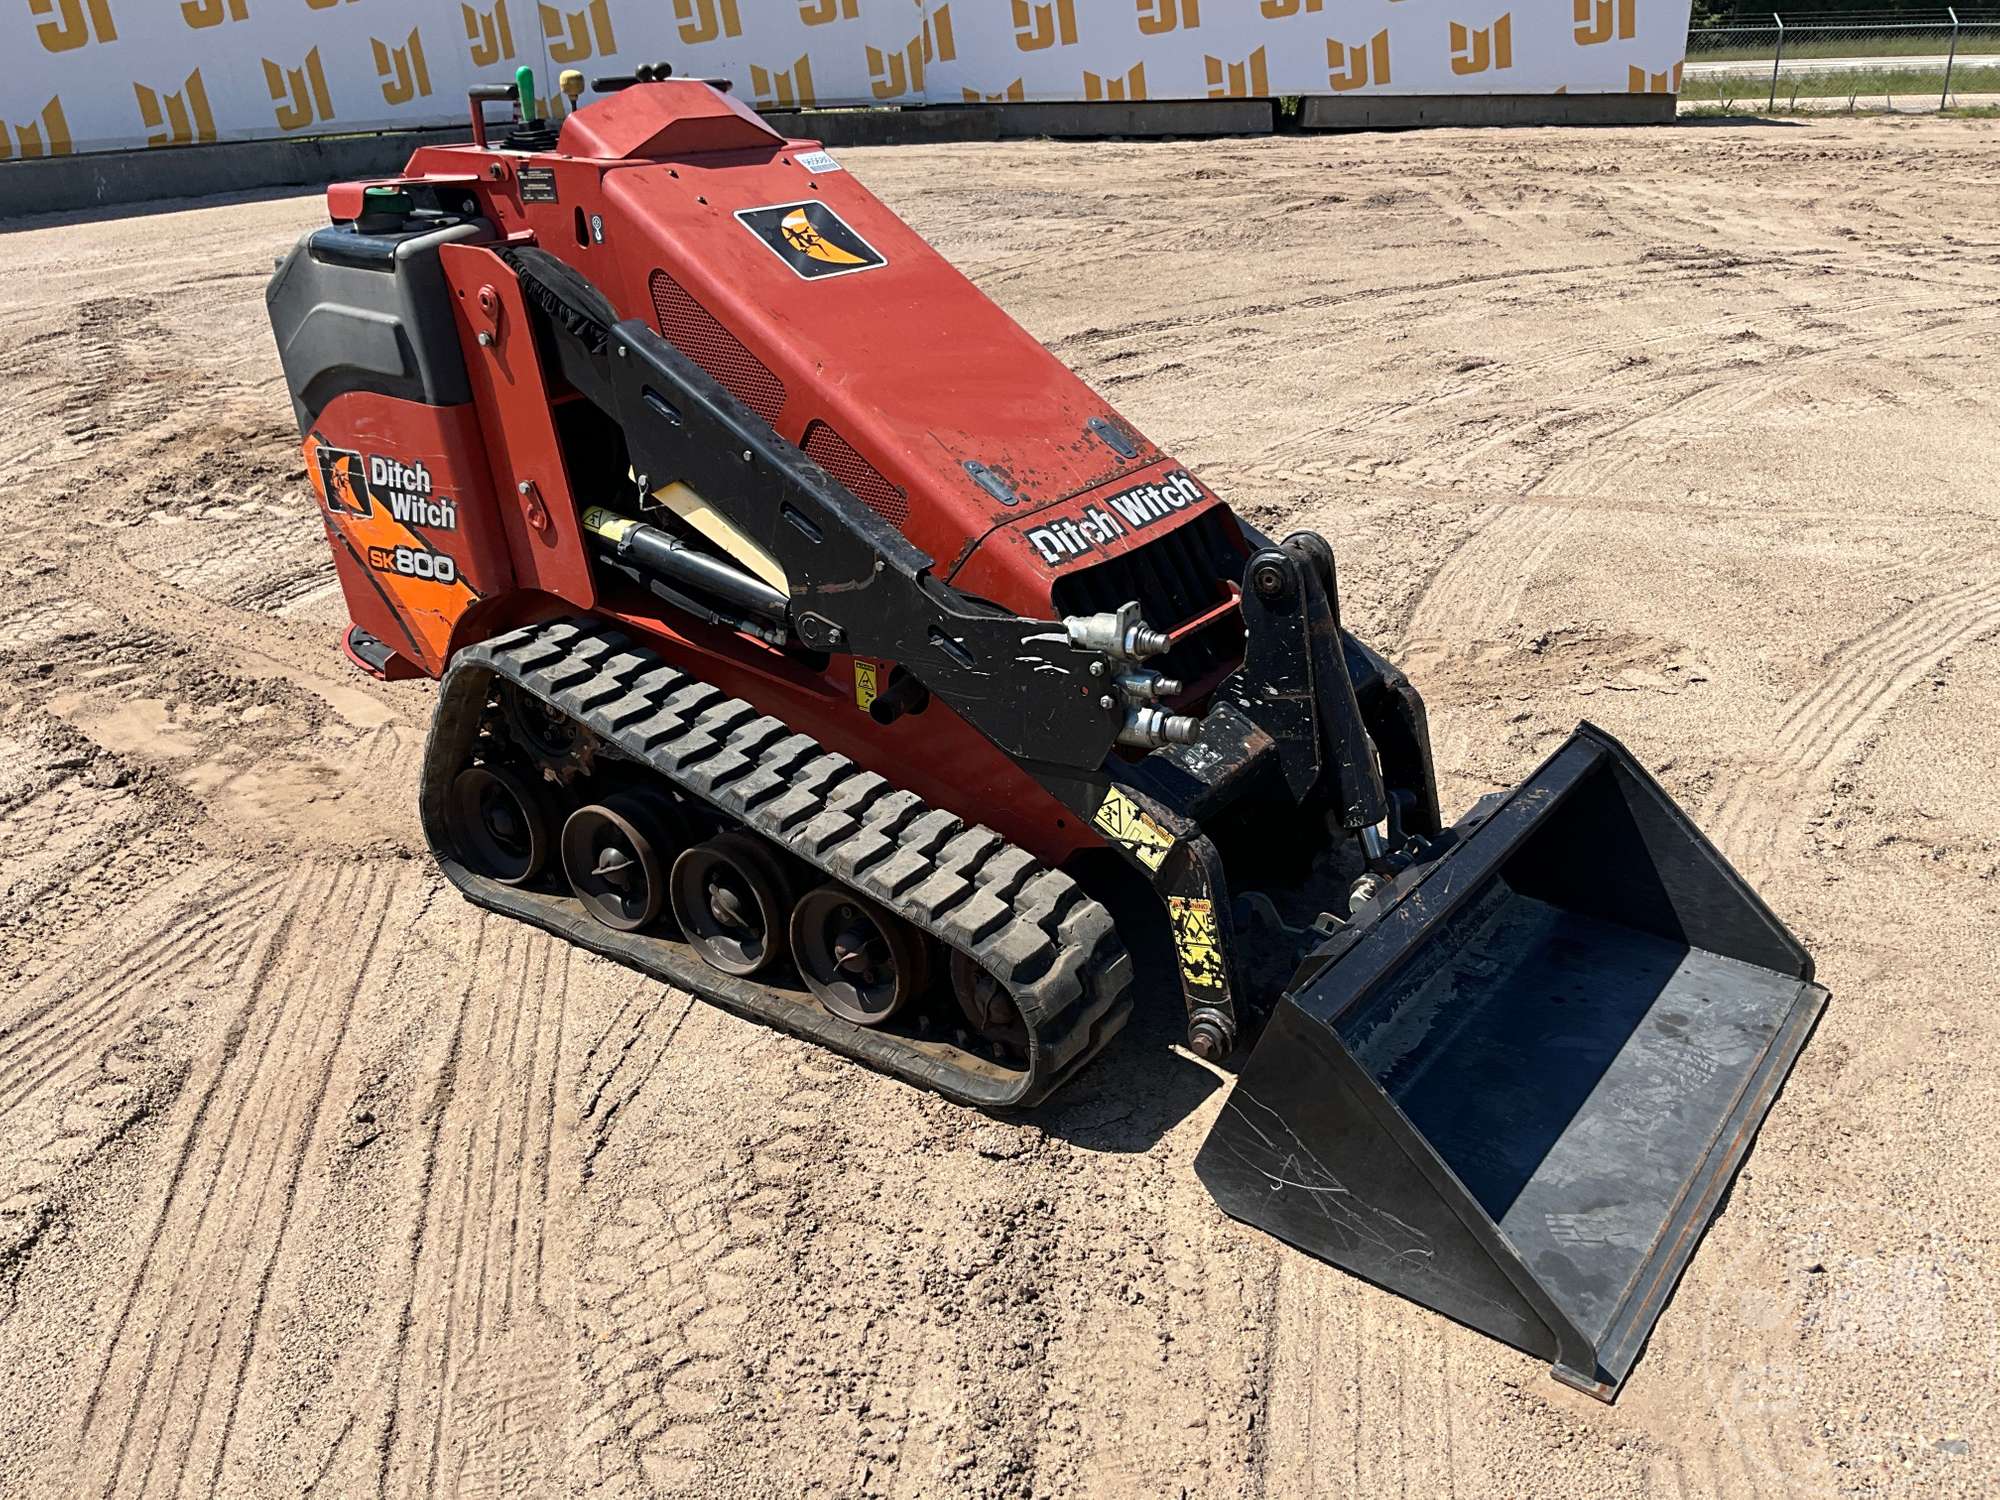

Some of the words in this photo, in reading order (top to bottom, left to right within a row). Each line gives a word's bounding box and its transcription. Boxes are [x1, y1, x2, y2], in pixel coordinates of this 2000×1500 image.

[371, 457, 431, 492] Ditch
[390, 491, 456, 529] Witch
[1028, 507, 1124, 564] Ditch
[1108, 474, 1202, 527] Witch
[369, 547, 455, 582] SK800
